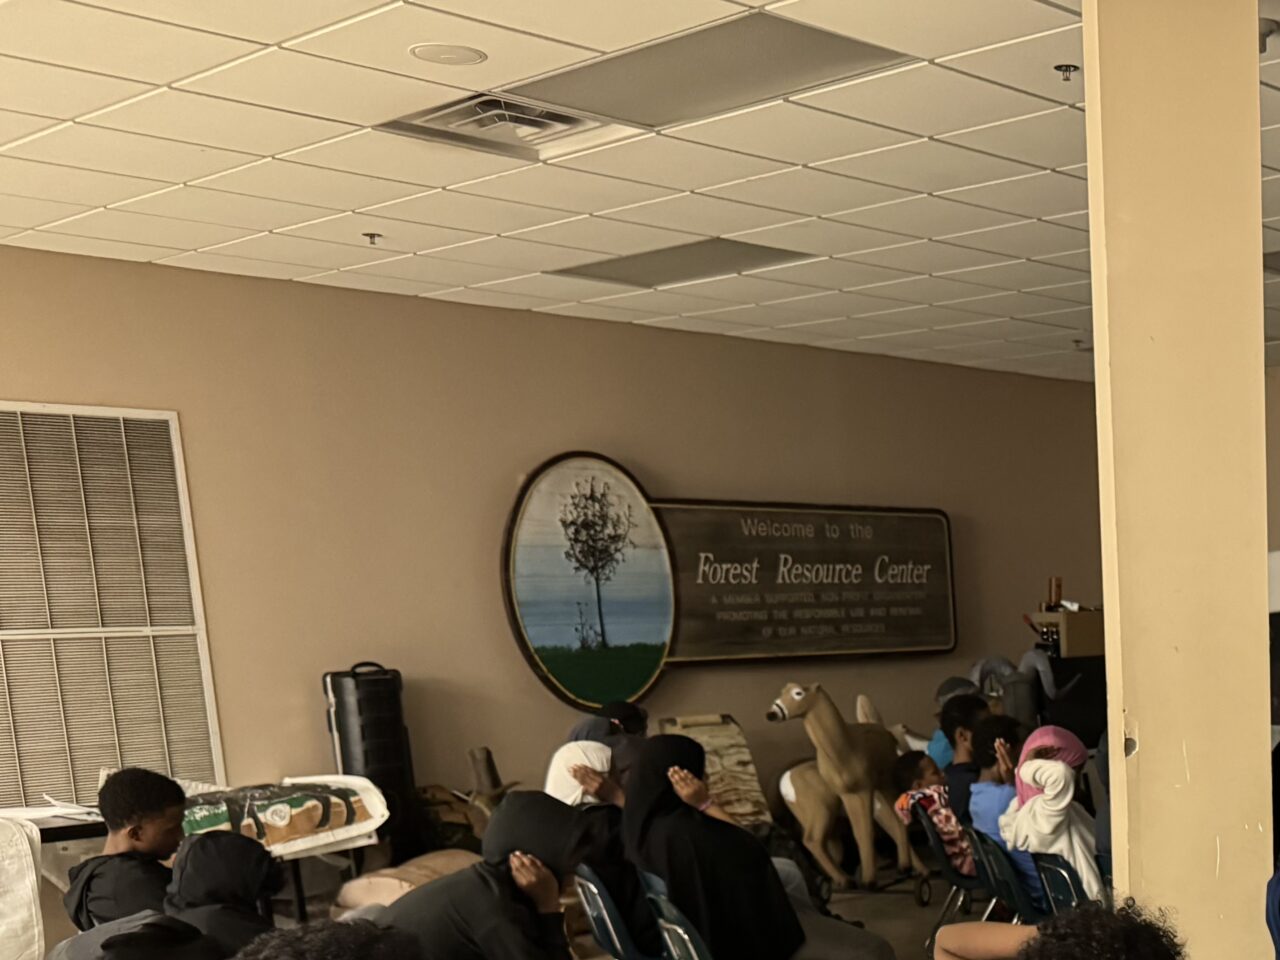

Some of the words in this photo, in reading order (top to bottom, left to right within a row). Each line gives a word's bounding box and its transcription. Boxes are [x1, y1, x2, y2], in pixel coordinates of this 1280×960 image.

[740, 518, 815, 539] Welcome
[825, 521, 840, 539] to
[850, 522, 873, 540] the
[696, 552, 760, 585] Forest
[776, 553, 862, 585] Resource
[874, 555, 932, 584] Center
